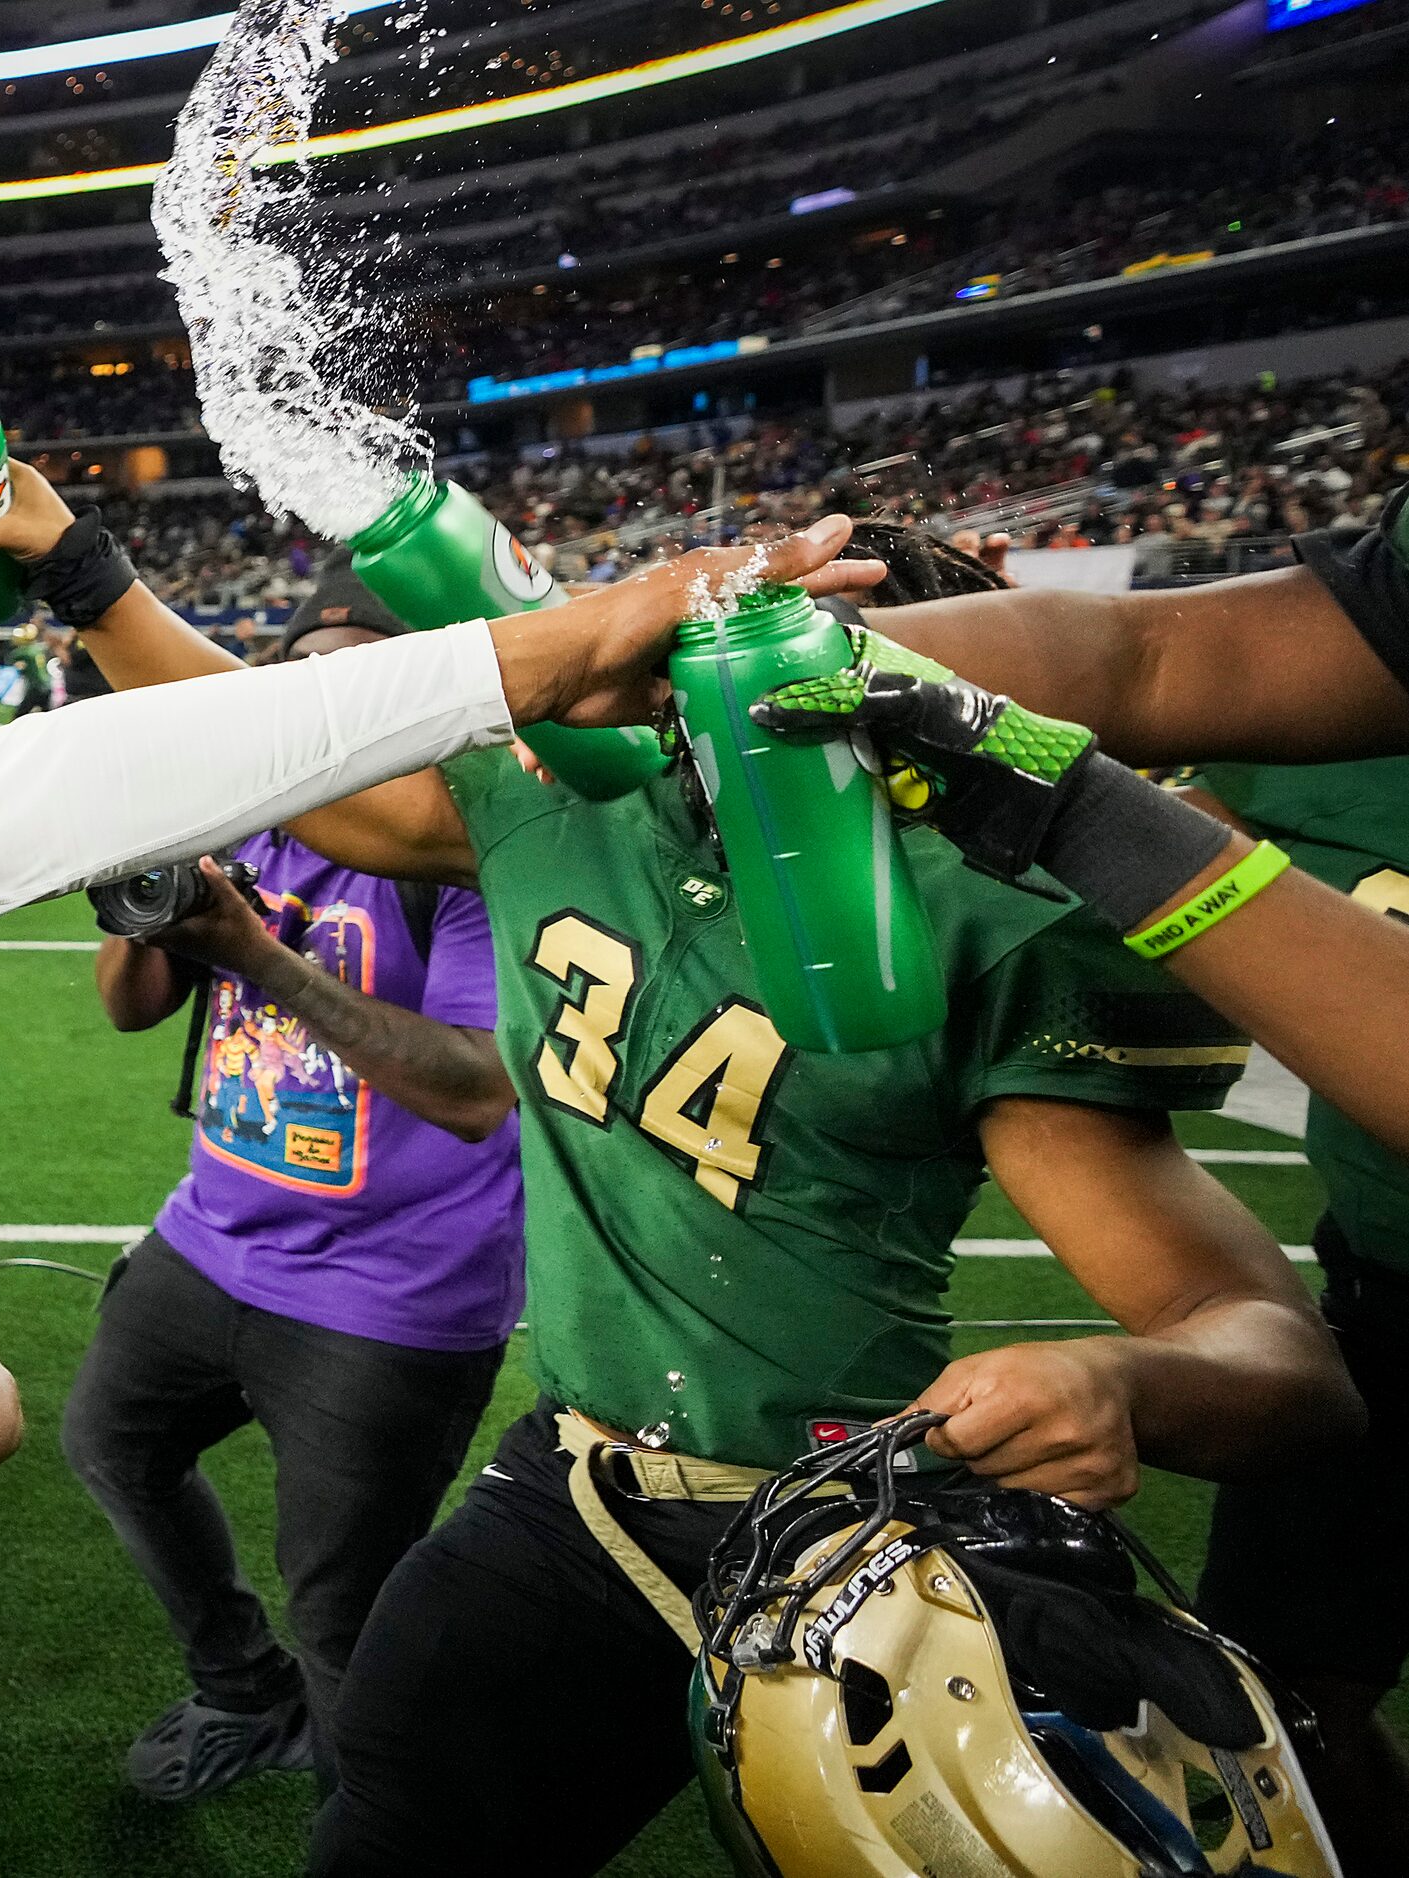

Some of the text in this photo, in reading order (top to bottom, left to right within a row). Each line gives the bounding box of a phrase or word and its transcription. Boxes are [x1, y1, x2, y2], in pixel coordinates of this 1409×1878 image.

[1143, 880, 1241, 951] FIND A WAY
[528, 907, 791, 1211] 34
